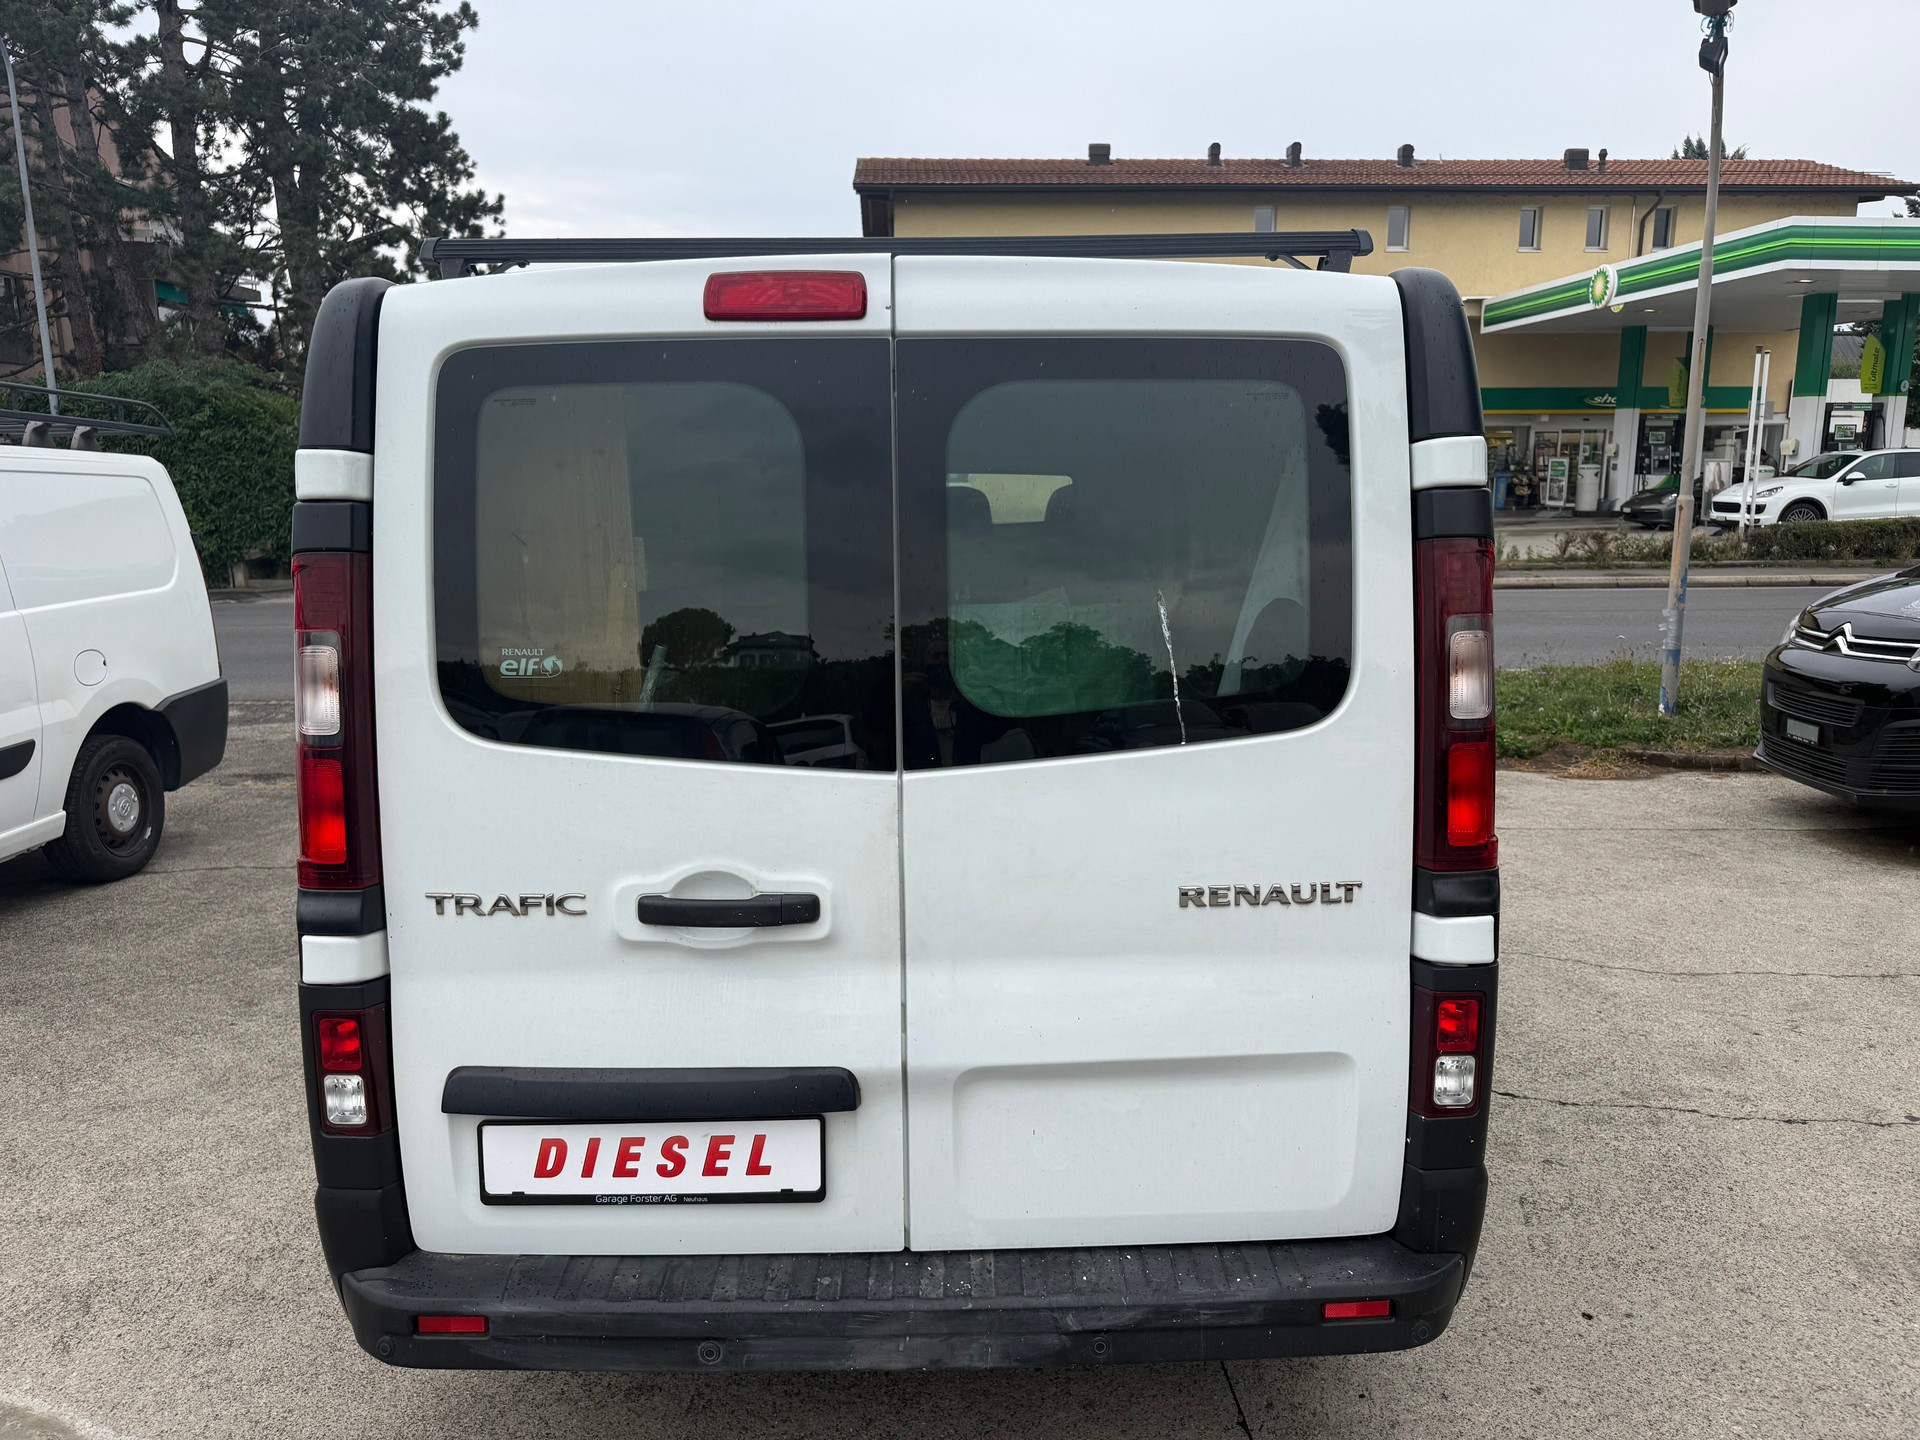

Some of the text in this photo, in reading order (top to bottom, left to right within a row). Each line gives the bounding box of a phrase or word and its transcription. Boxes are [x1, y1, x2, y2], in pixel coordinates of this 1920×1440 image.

[501, 648, 545, 656] RENAULT
[500, 657, 540, 676] elf
[425, 892, 587, 916] TRAFIC
[1178, 880, 1363, 908] RENAULT
[533, 1134, 772, 1179] DIESEL
[595, 1194, 628, 1204] Garage
[630, 1194, 662, 1203] Forster
[663, 1194, 677, 1203] AG
